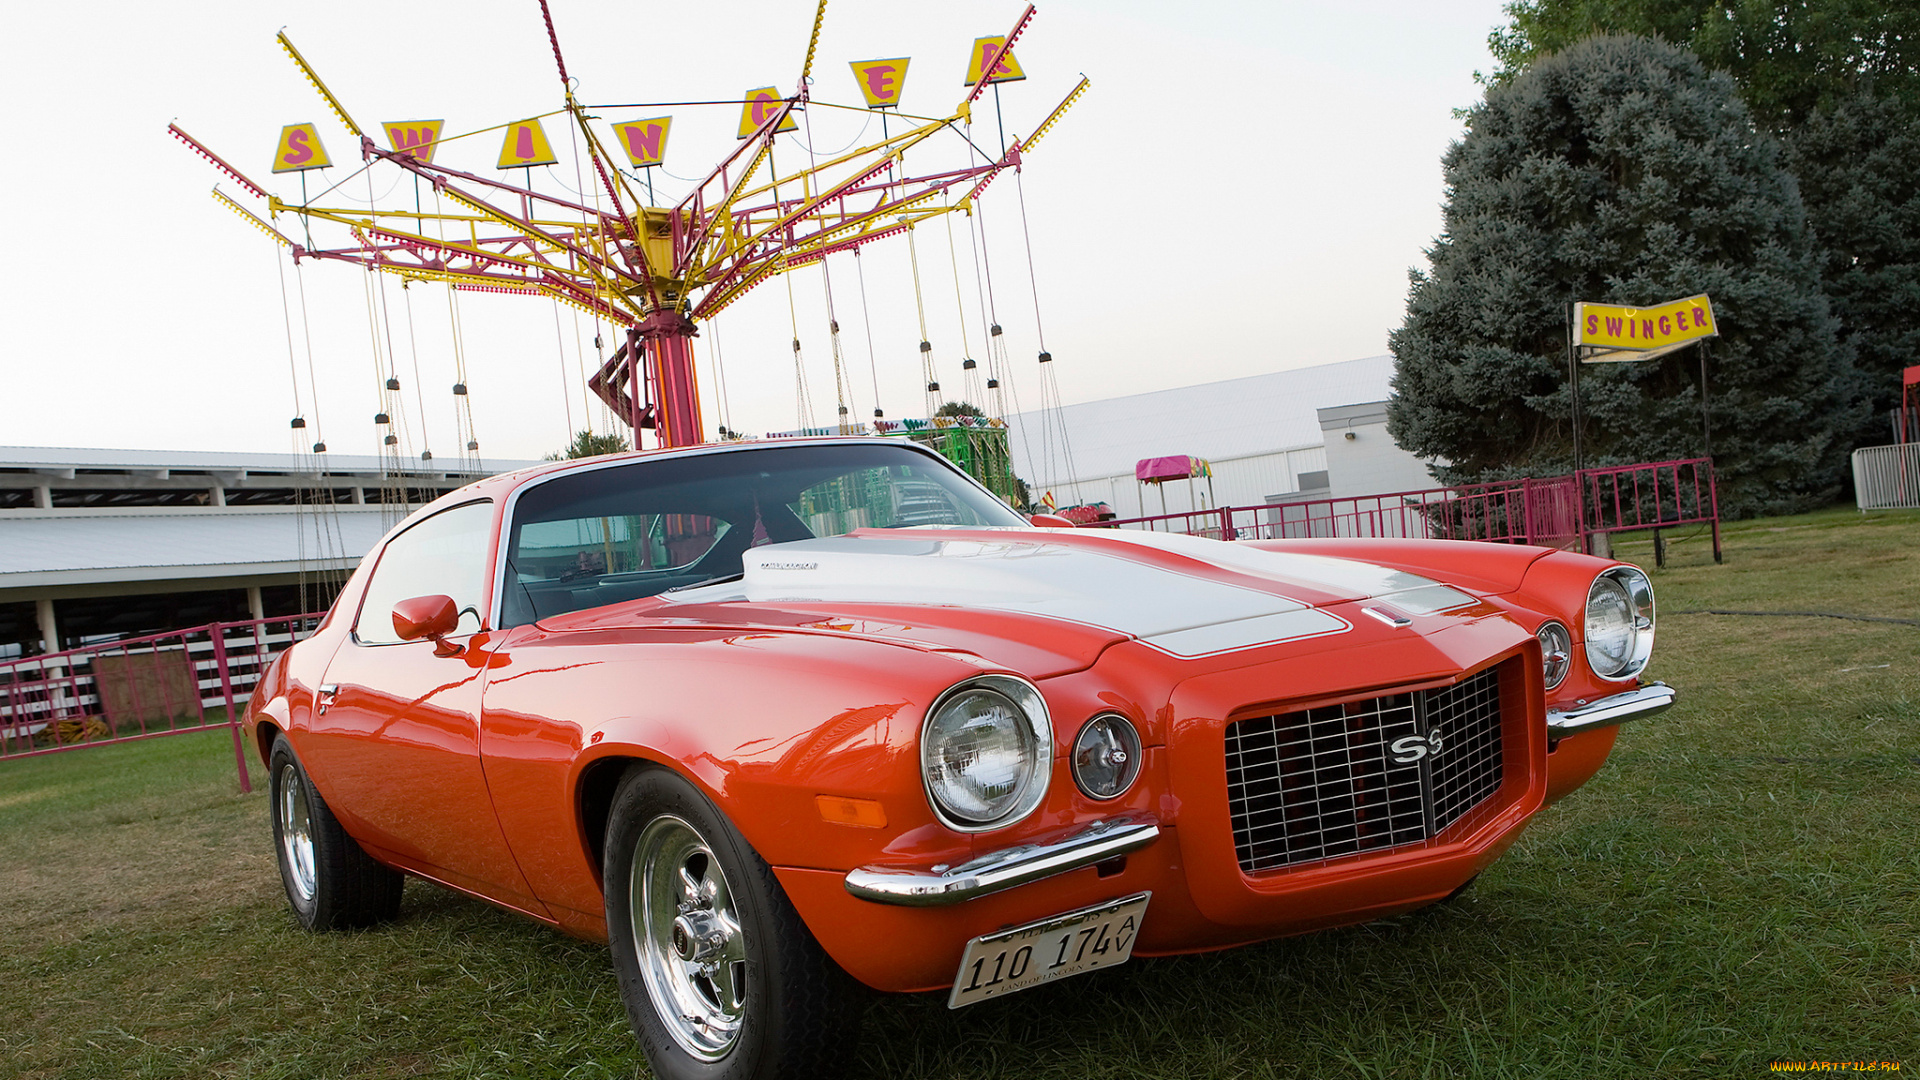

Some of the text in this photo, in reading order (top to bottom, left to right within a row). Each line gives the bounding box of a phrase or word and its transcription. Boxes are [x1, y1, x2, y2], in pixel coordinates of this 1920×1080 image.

[283, 129, 314, 165] S
[390, 127, 434, 160] W
[516, 126, 531, 158] I
[624, 124, 663, 159] N
[862, 65, 897, 100] E
[980, 43, 1012, 74] R
[1586, 307, 1708, 339] SWINGER
[1391, 729, 1443, 762] SS
[961, 924, 1111, 994] 110 174
[1000, 977, 1027, 992] LAND
[1042, 963, 1085, 980] LINCOLN
